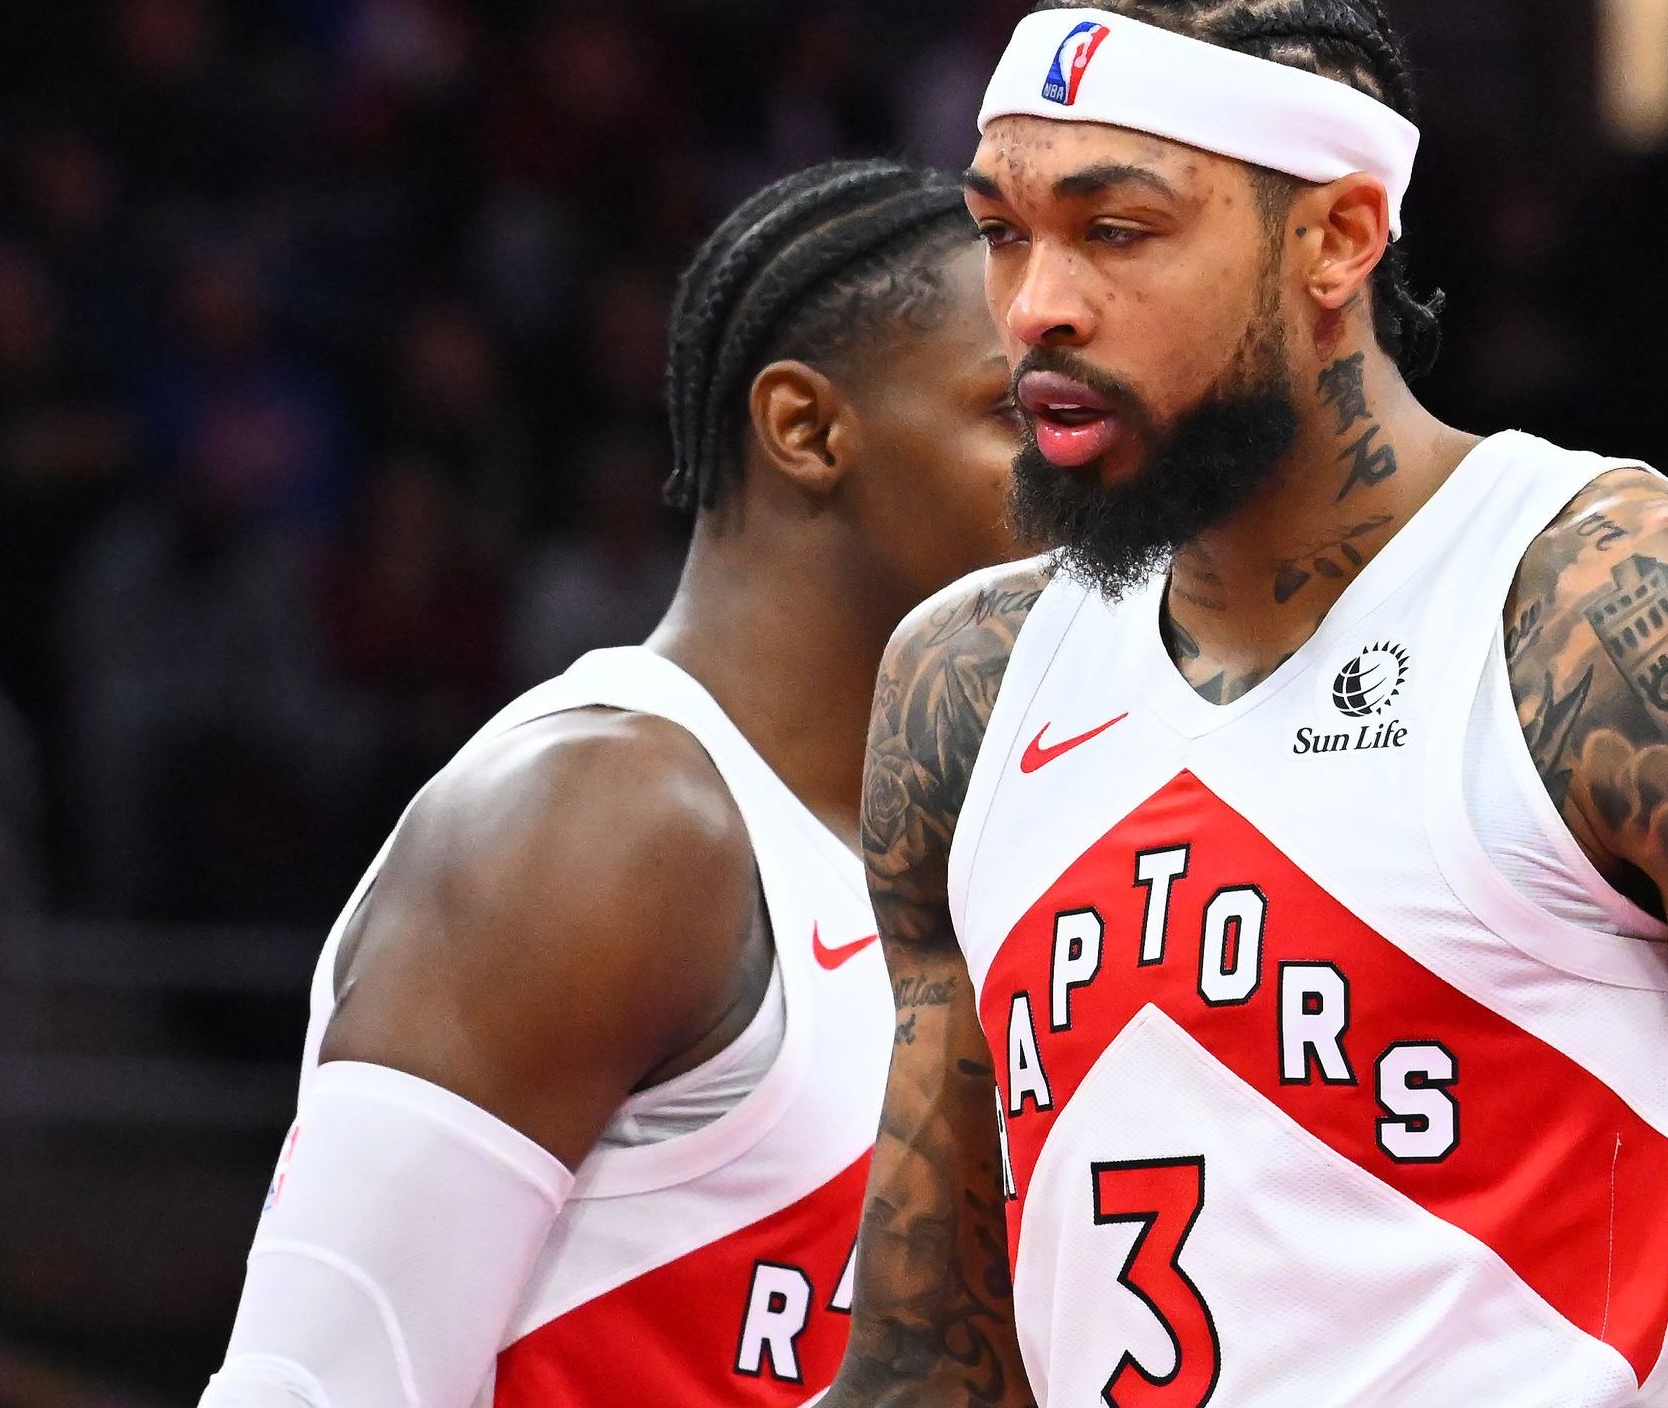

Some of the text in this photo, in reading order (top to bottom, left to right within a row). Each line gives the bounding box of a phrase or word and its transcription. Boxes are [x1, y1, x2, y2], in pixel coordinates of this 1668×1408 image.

[1044, 83, 1064, 100] NBA
[1293, 719, 1408, 755] Sun Life
